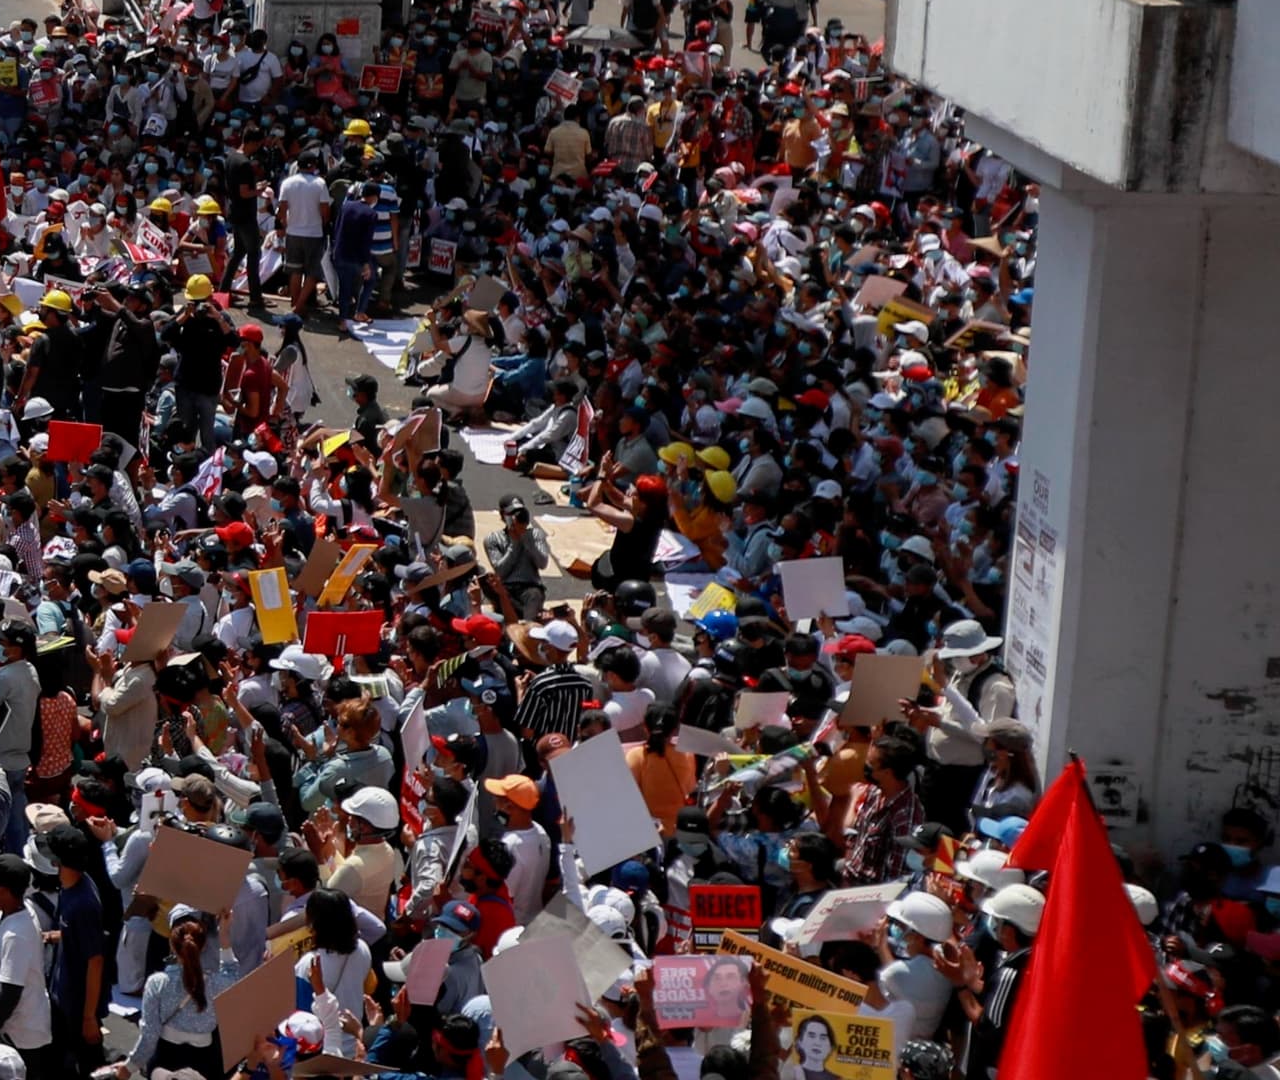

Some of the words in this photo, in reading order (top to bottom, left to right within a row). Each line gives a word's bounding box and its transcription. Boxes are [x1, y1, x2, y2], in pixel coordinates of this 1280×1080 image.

[143, 230, 171, 259] CDM
[697, 892, 756, 920] REJECT
[720, 936, 738, 954] We
[764, 957, 799, 981] accept
[799, 971, 838, 999] military
[837, 987, 864, 1007] coup
[847, 1023, 880, 1037] FREE
[837, 1044, 891, 1060] LEADER
[848, 1035, 879, 1048] OUR
